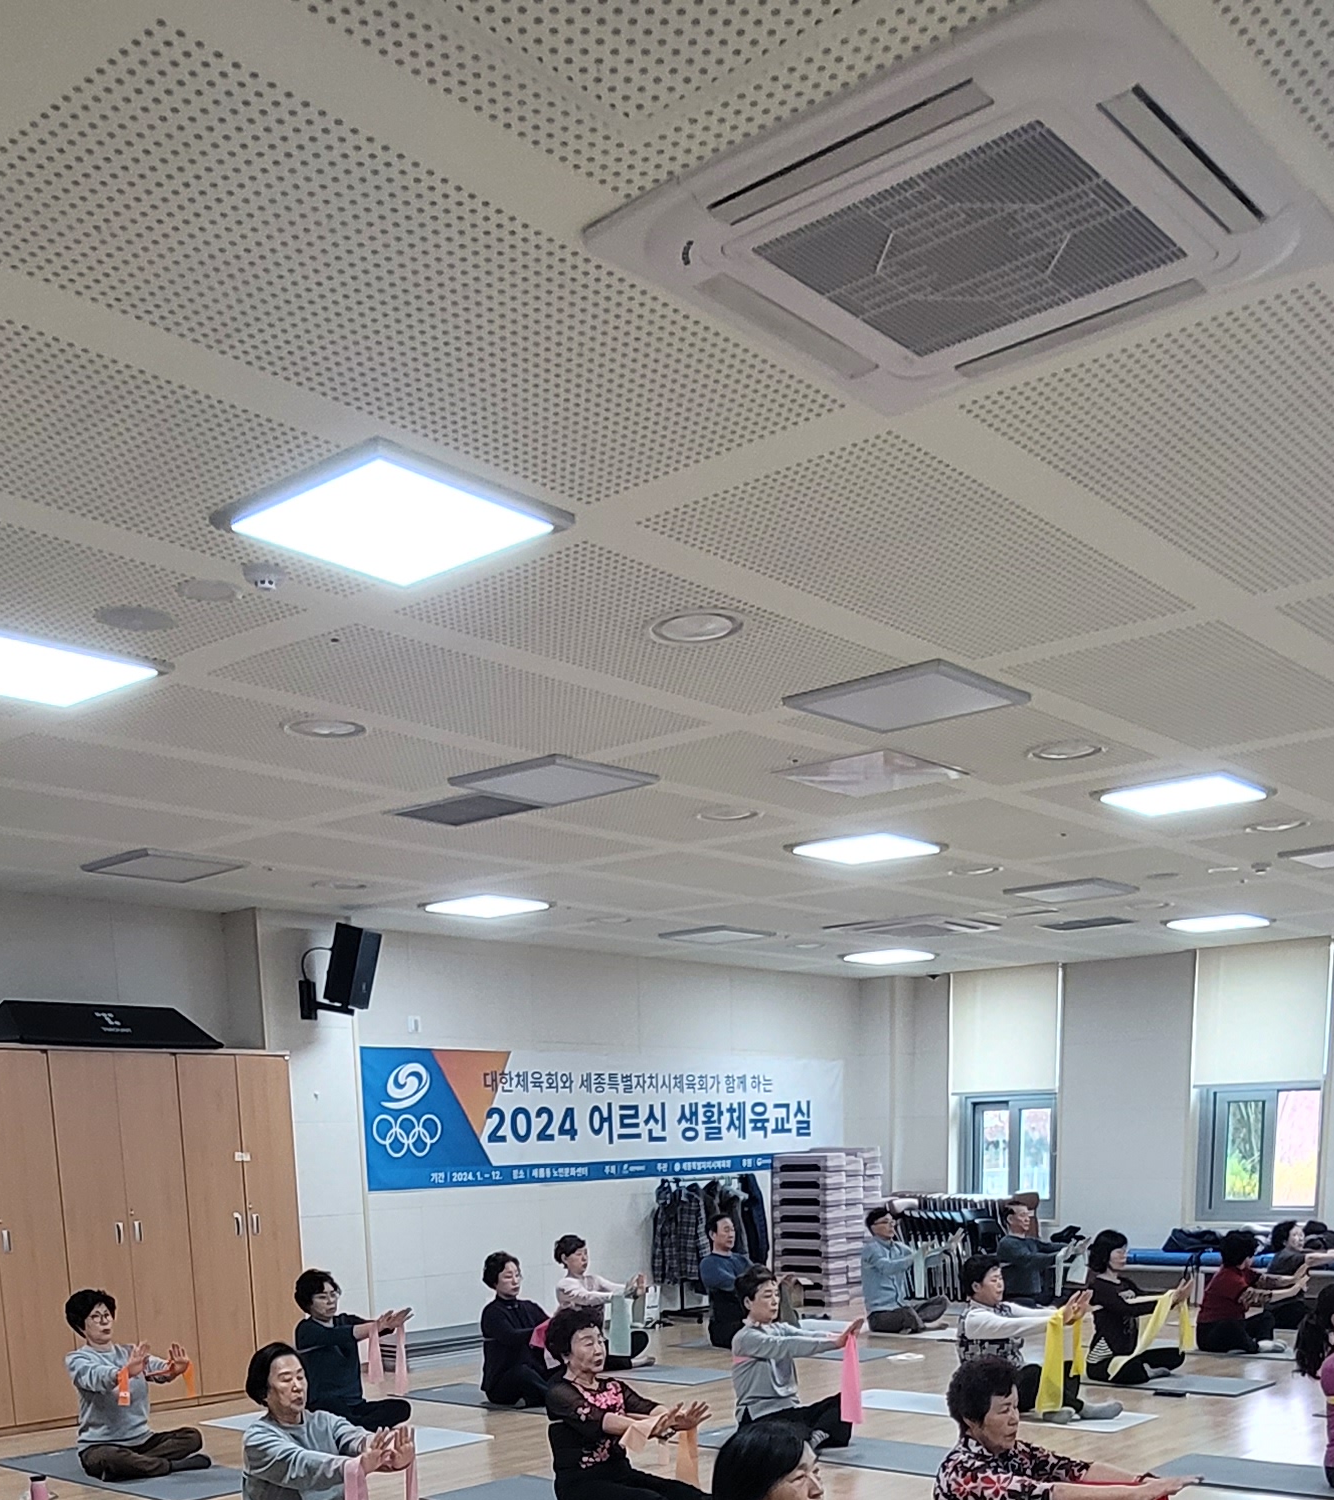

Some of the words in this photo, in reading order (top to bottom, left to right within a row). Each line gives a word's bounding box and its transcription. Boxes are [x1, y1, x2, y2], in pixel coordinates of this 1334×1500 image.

[483, 1070, 574, 1093] 대한체육회와
[579, 1071, 721, 1095] 세종특별자치시체육회가
[723, 1074, 747, 1094] 함께
[750, 1074, 773, 1094] 하는
[486, 1105, 578, 1144] 2024
[589, 1101, 668, 1145] 어르신
[676, 1099, 812, 1144] 생활체육교실
